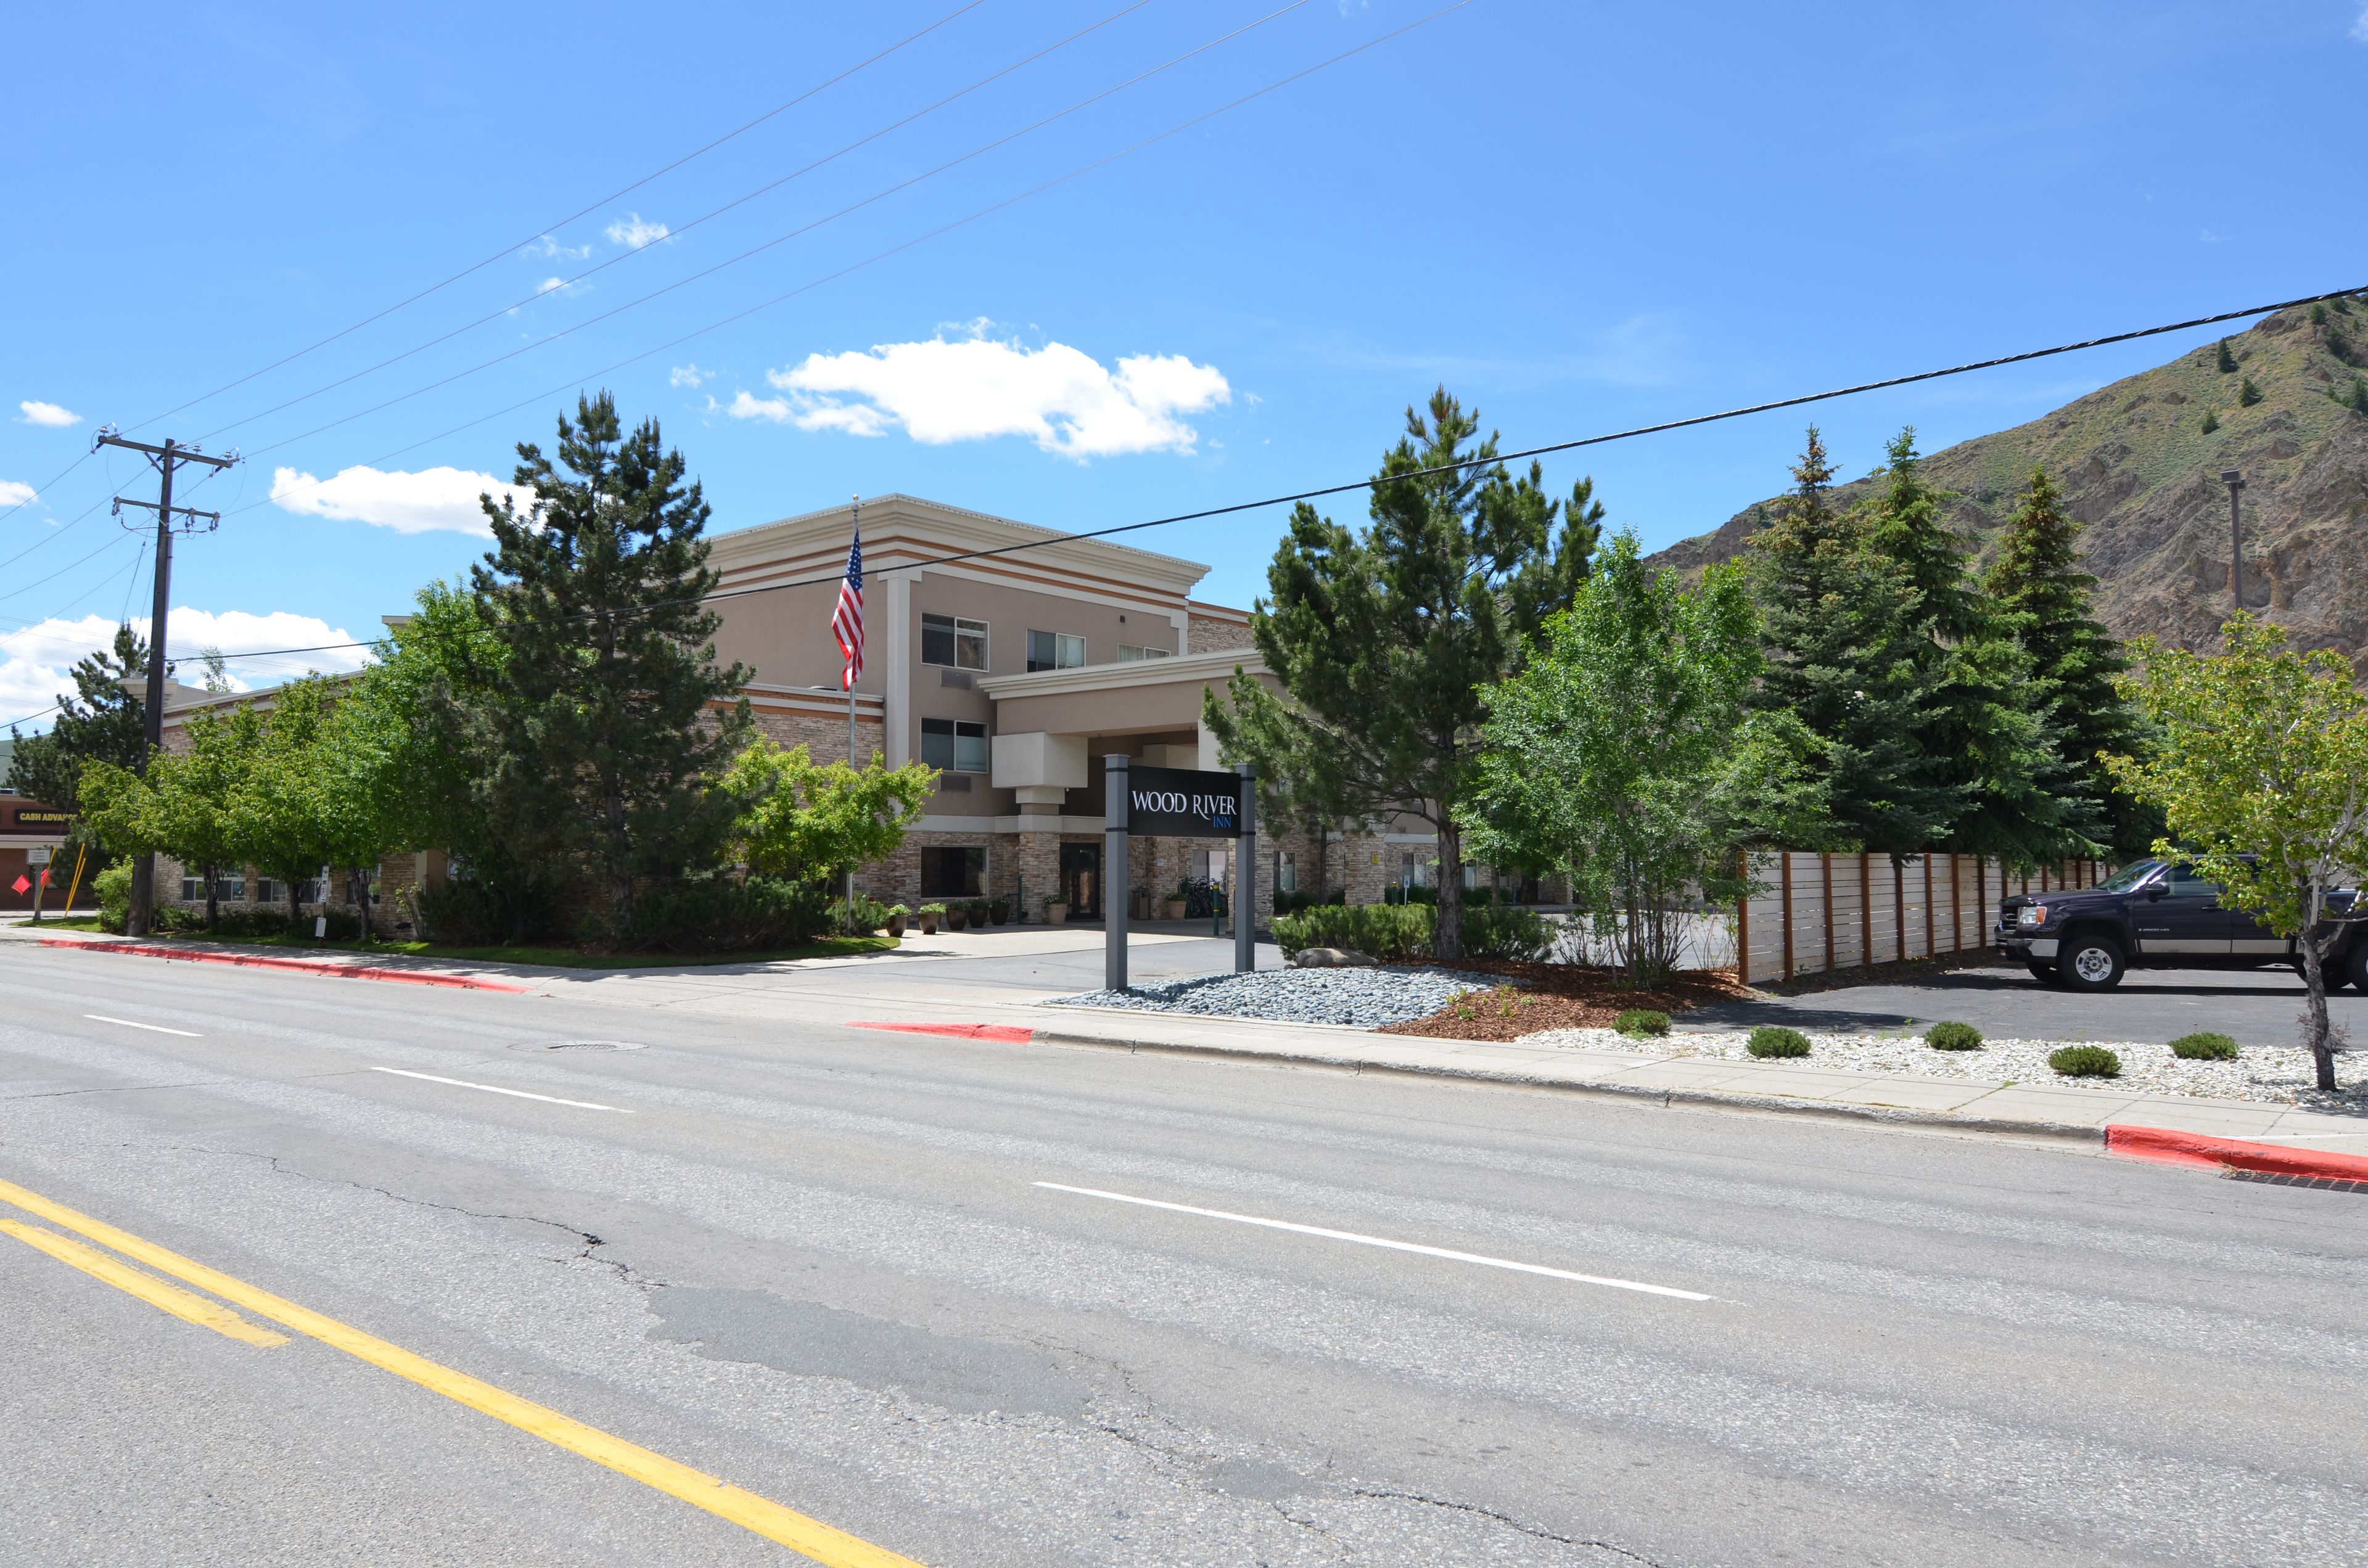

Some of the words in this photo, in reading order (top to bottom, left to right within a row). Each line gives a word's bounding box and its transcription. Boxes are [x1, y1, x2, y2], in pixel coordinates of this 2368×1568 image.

[1132, 790, 1187, 813] WOOD
[1193, 795, 1237, 820] RIVER
[20, 813, 41, 821] CASH
[1213, 816, 1231, 828] INN
